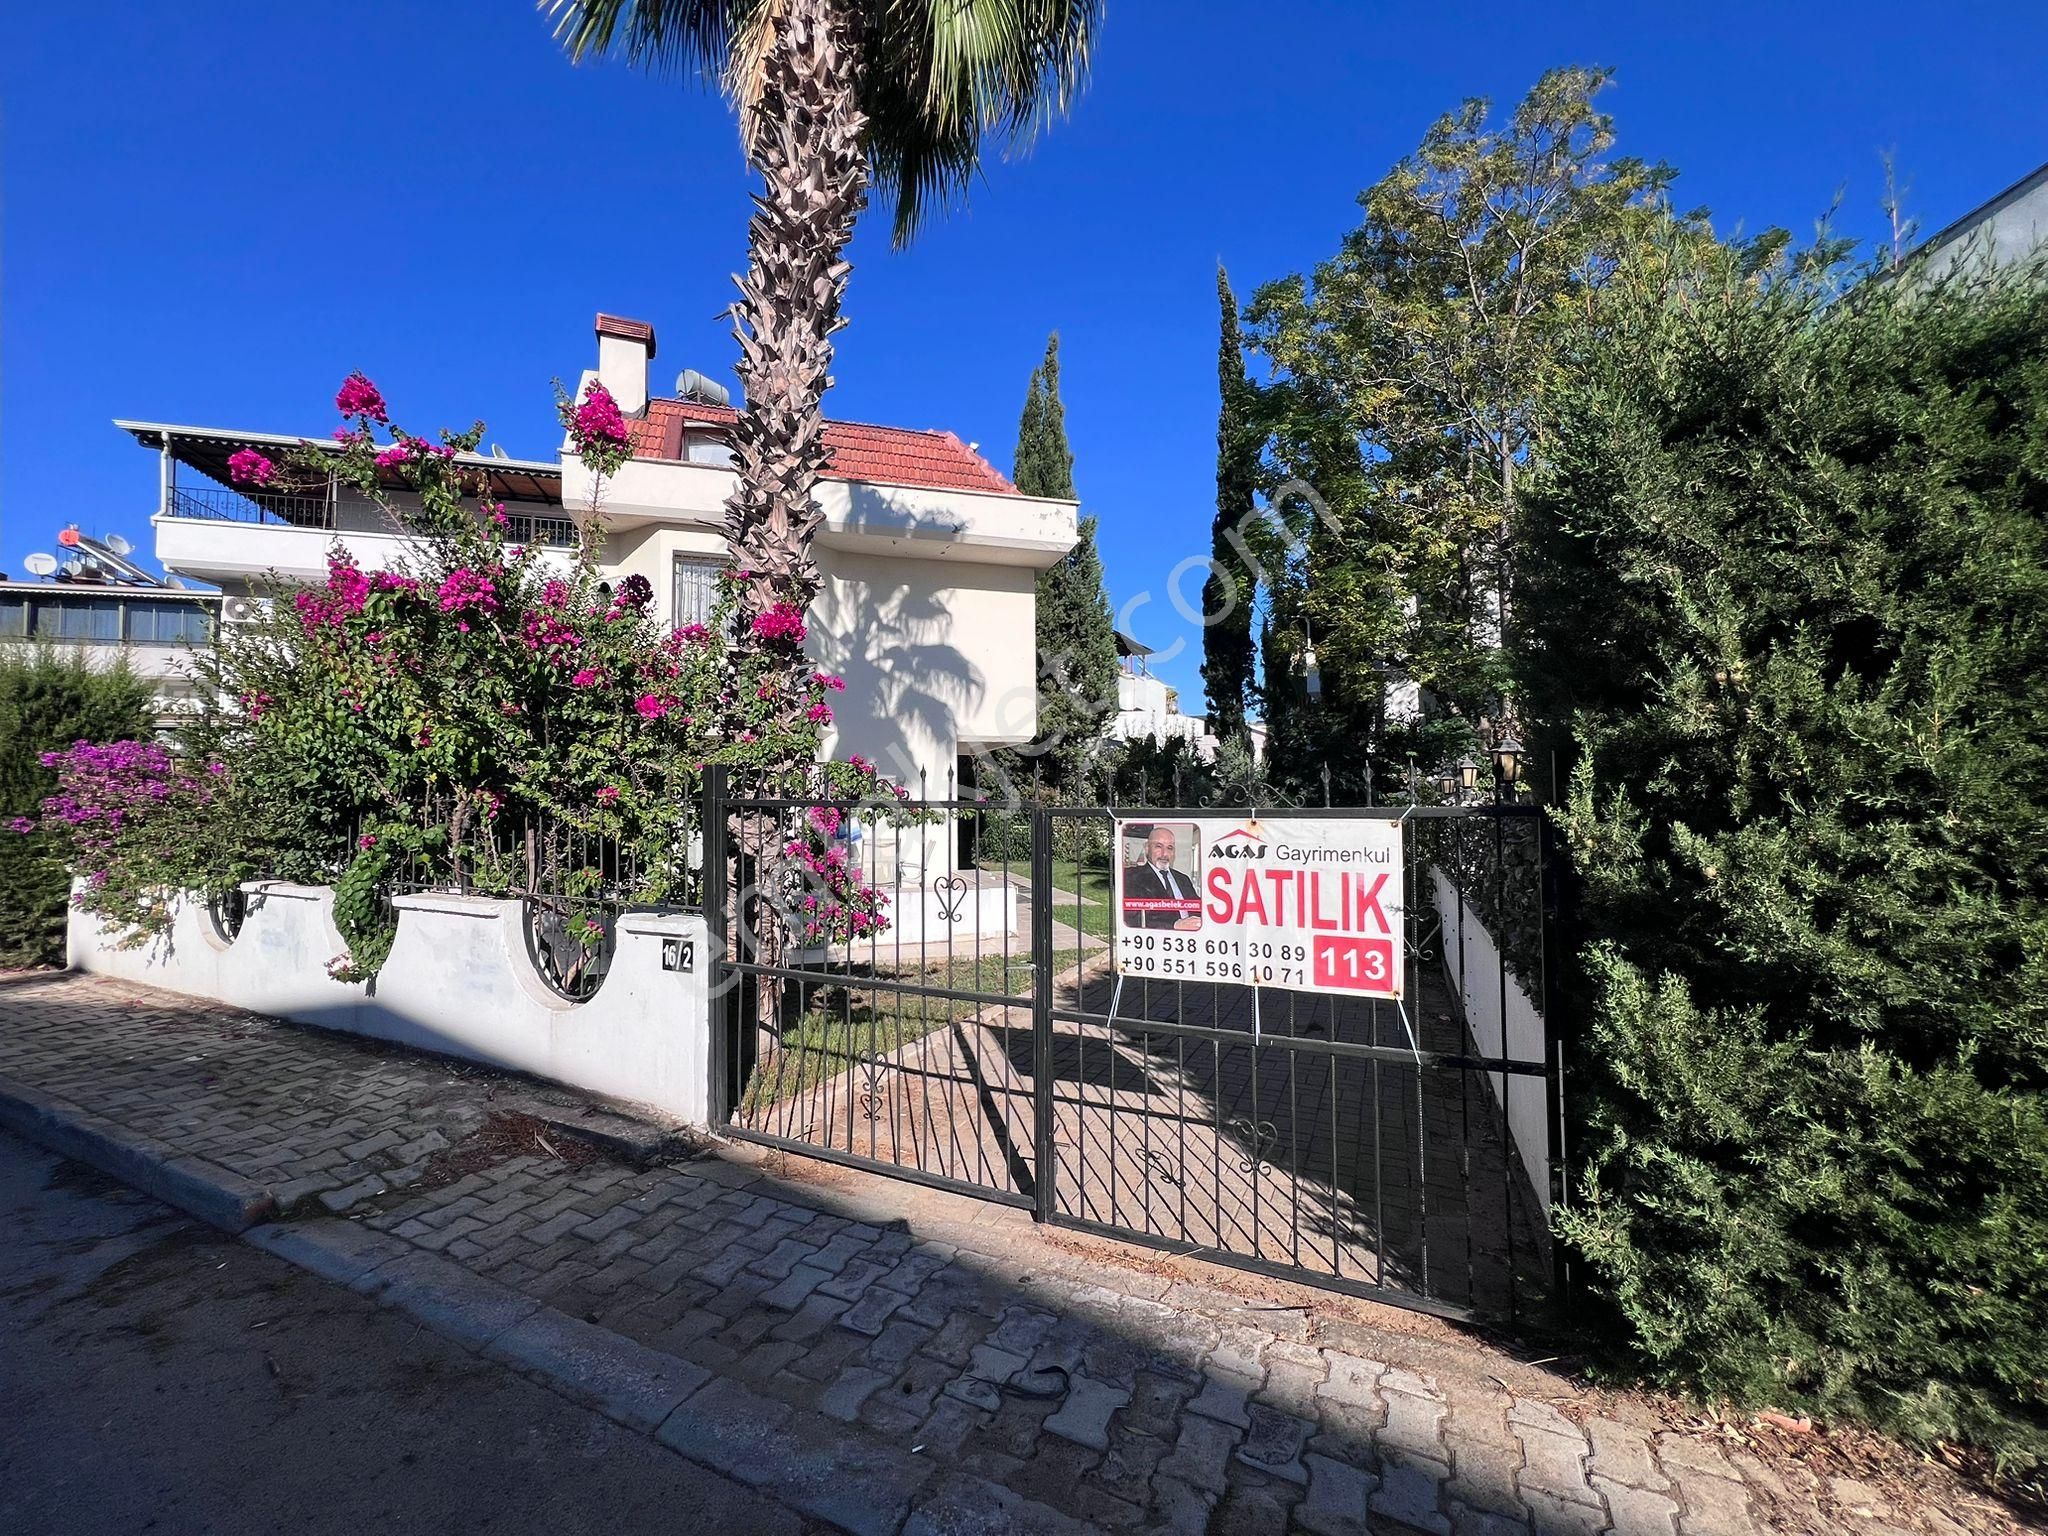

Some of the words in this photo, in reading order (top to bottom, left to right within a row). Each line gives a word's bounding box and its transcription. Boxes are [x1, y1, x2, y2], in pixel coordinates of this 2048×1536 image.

[1276, 844, 1390, 864] Gayrimenkul
[1124, 901, 1200, 910] www.agasbelek.com
[1206, 867, 1391, 934] SATILIK
[663, 941, 692, 970] 16/2
[1122, 935, 1155, 951] +90
[1162, 937, 1197, 953] 538
[1205, 940, 1239, 956] 601
[1249, 942, 1272, 959] 30
[1281, 945, 1306, 962] 89
[1122, 956, 1155, 971] +90
[1162, 958, 1196, 975] 551
[1206, 961, 1242, 978] 596
[1249, 964, 1273, 982] 10
[1281, 967, 1304, 985] 71
[1320, 946, 1386, 981] 113
